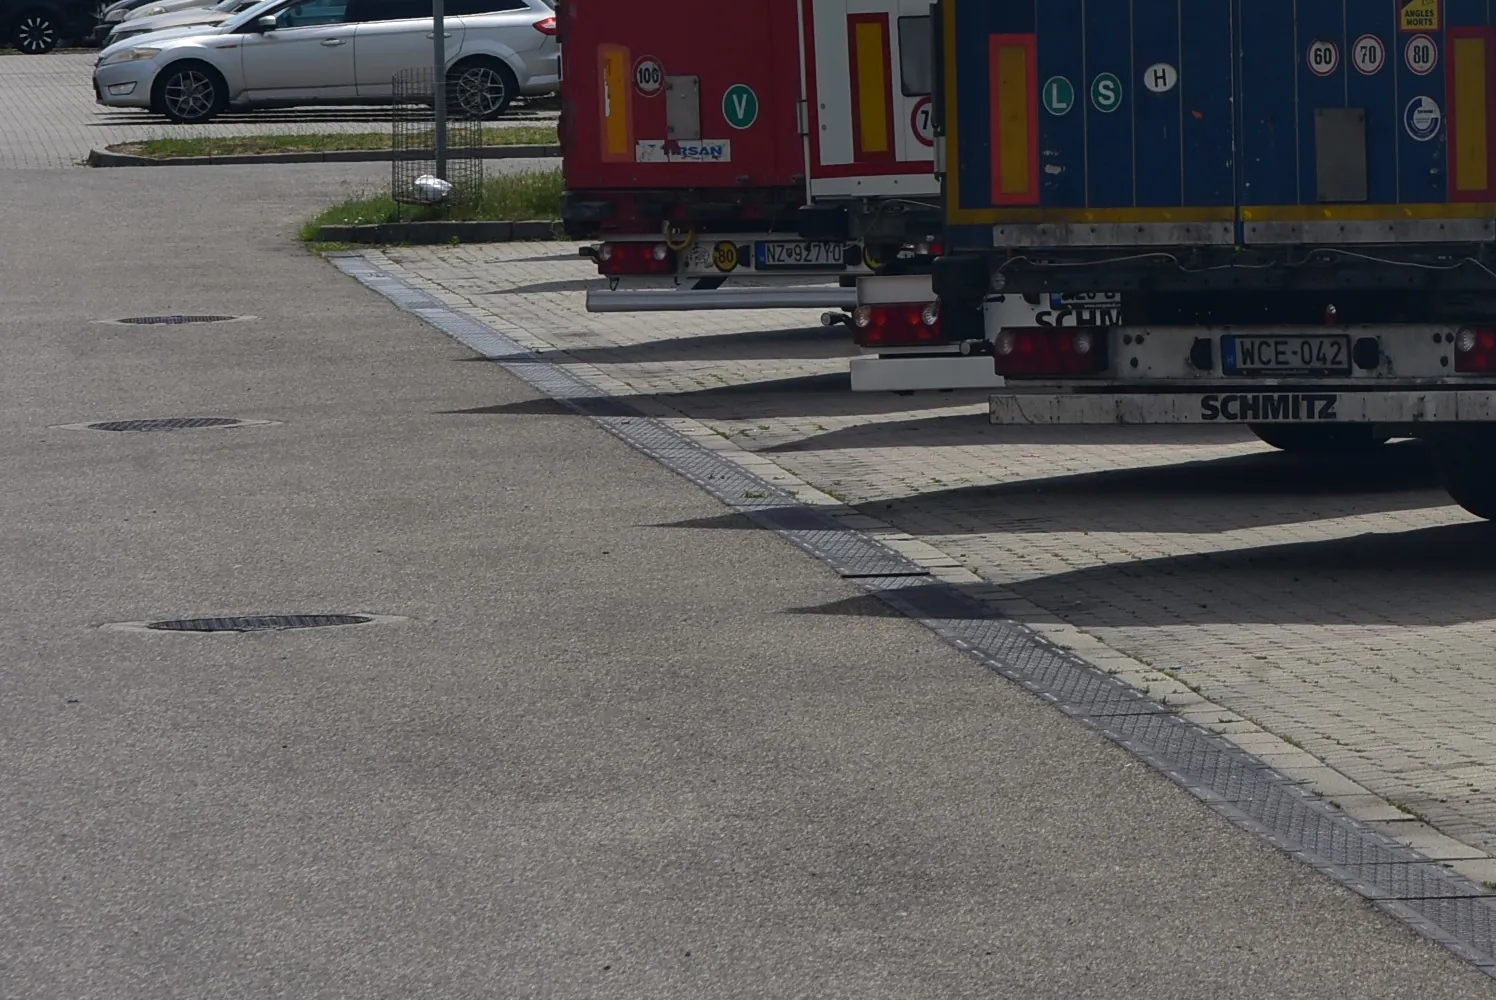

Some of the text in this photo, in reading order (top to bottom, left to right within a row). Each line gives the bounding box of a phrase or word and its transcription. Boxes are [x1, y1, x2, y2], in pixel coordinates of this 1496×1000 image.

[1405, 9, 1434, 18] ANGLES
[1406, 18, 1433, 26] MORTS
[1314, 47, 1332, 65] 60
[1360, 45, 1377, 64] 70
[1413, 45, 1429, 64] 80
[1153, 68, 1166, 87] H
[1052, 83, 1067, 108] L
[1098, 80, 1115, 105] S
[732, 94, 748, 119] V
[1240, 340, 1342, 365] WCE-042
[1201, 394, 1337, 420] SCHMITZ
